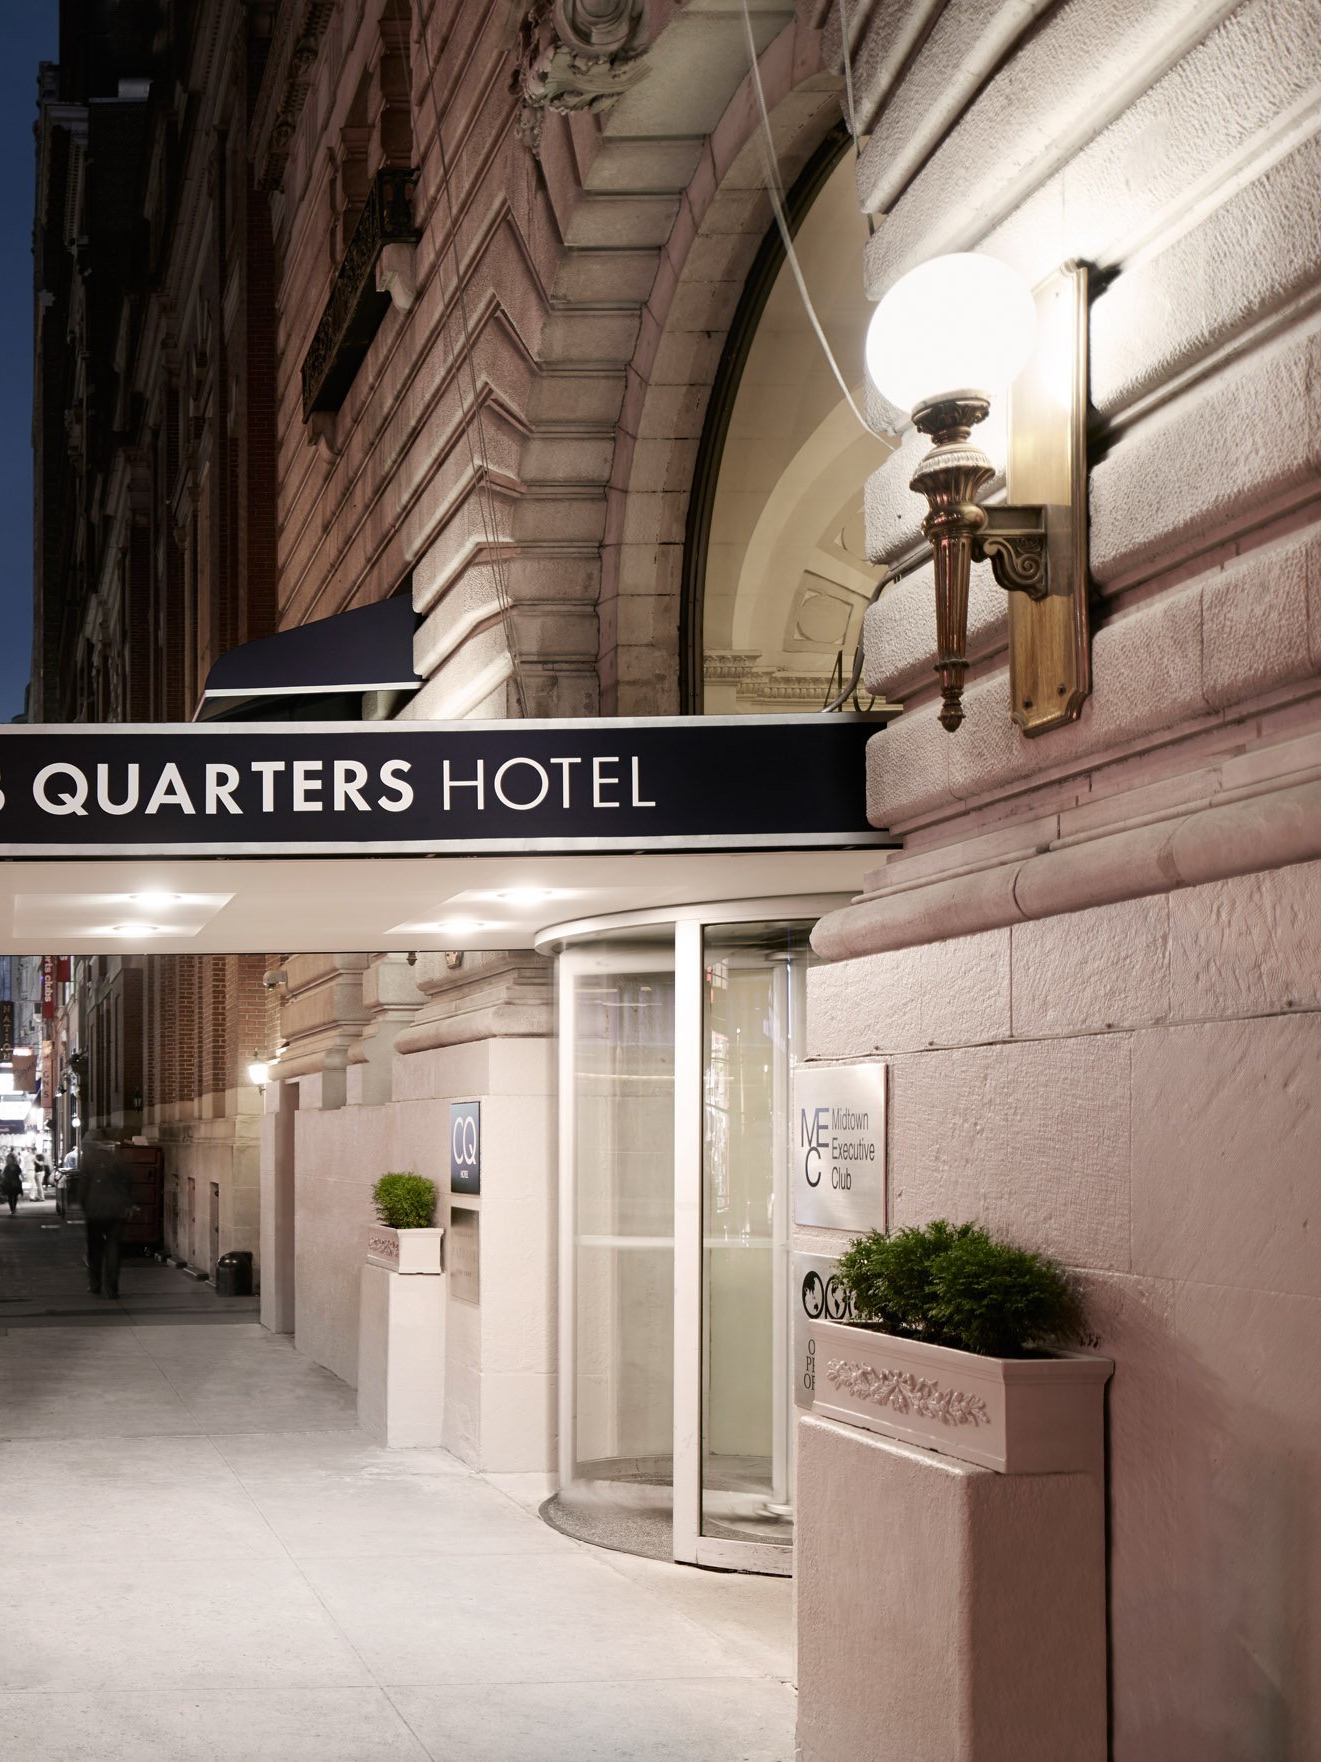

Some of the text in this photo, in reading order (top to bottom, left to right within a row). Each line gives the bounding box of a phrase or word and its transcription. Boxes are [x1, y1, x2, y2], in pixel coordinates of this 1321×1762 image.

[32, 759, 414, 816] QUARTERS
[443, 756, 656, 811] HOTEL
[44, 975, 53, 1002] clubs
[2, 1005, 11, 1060] NATION
[832, 1108, 869, 1130] Midtown
[453, 1116, 477, 1165] CQ
[832, 1137, 875, 1161] Executive
[831, 1166, 852, 1190] Club
